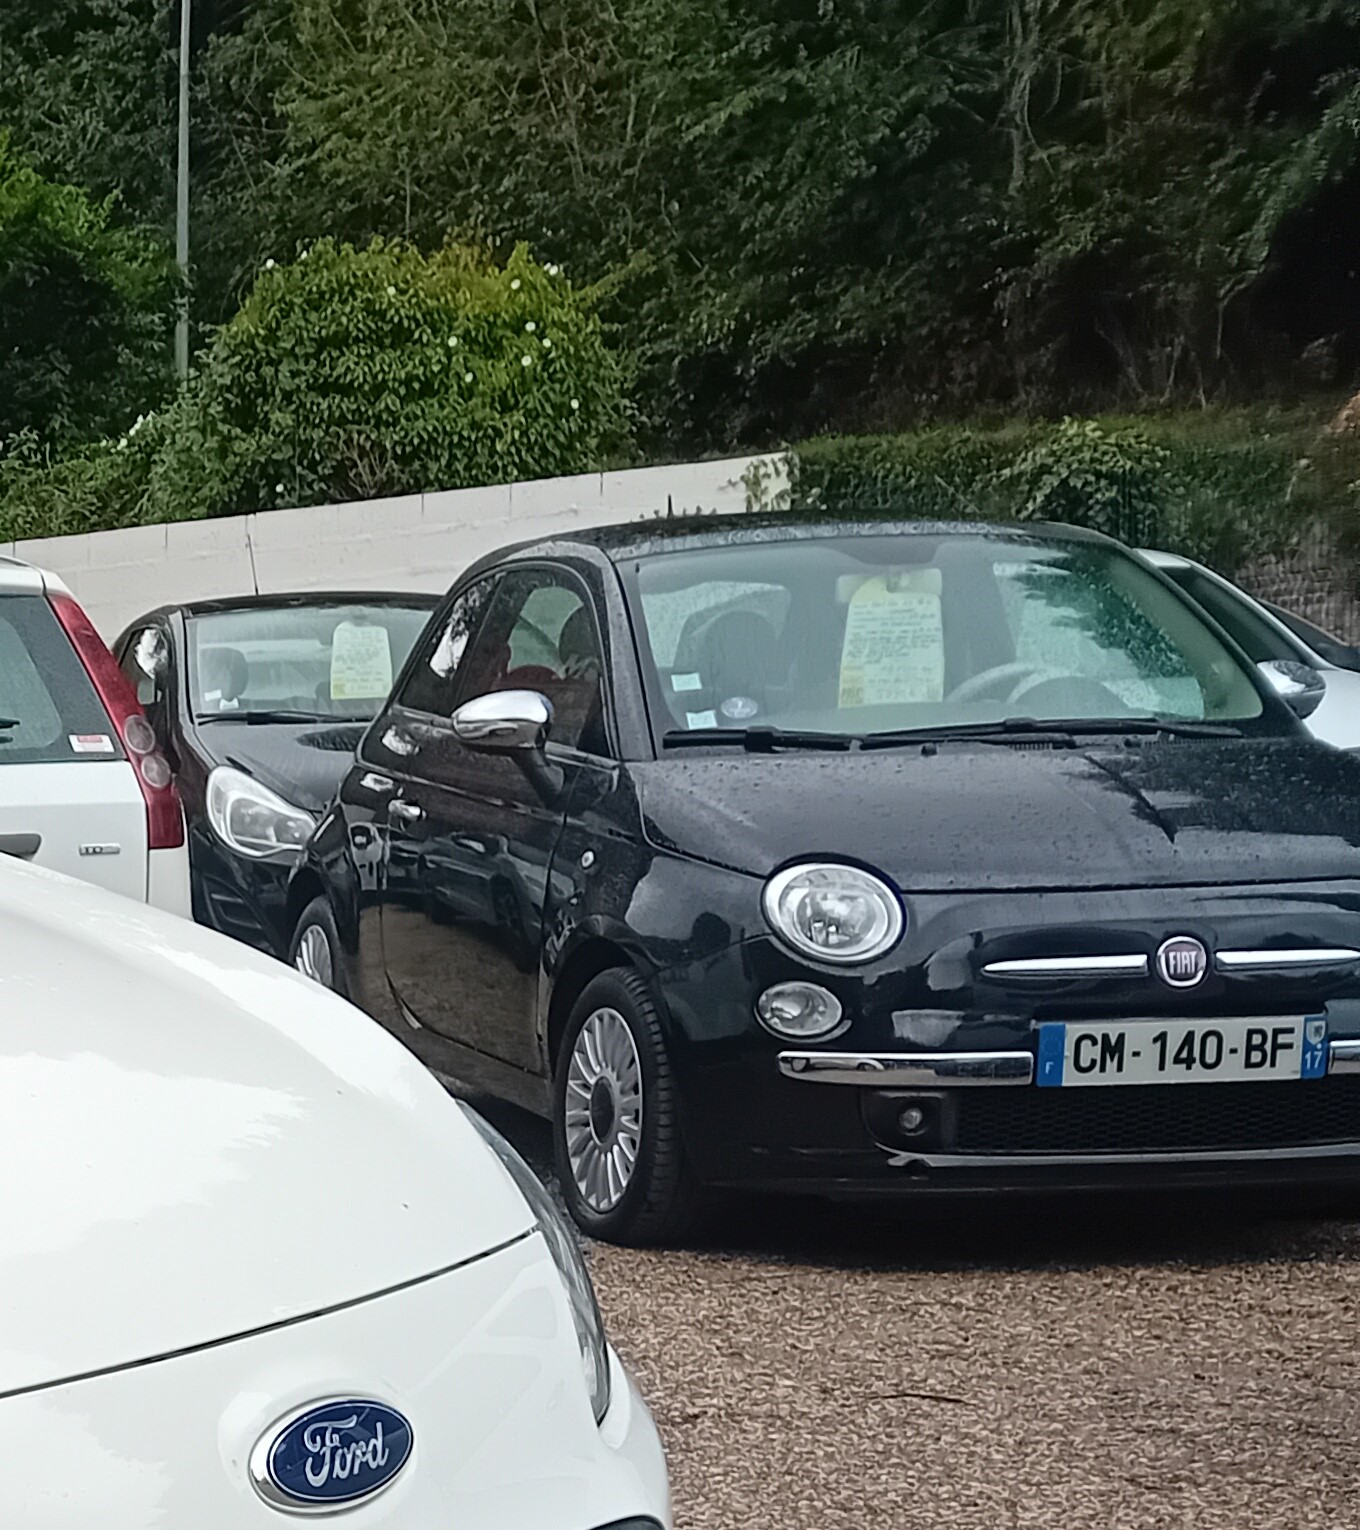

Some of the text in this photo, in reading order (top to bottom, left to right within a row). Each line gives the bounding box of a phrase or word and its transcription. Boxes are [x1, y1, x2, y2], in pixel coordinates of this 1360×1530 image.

[1167, 950, 1198, 975] FIAT
[1304, 1050, 1323, 1070] 17
[303, 1414, 389, 1488] Ford
